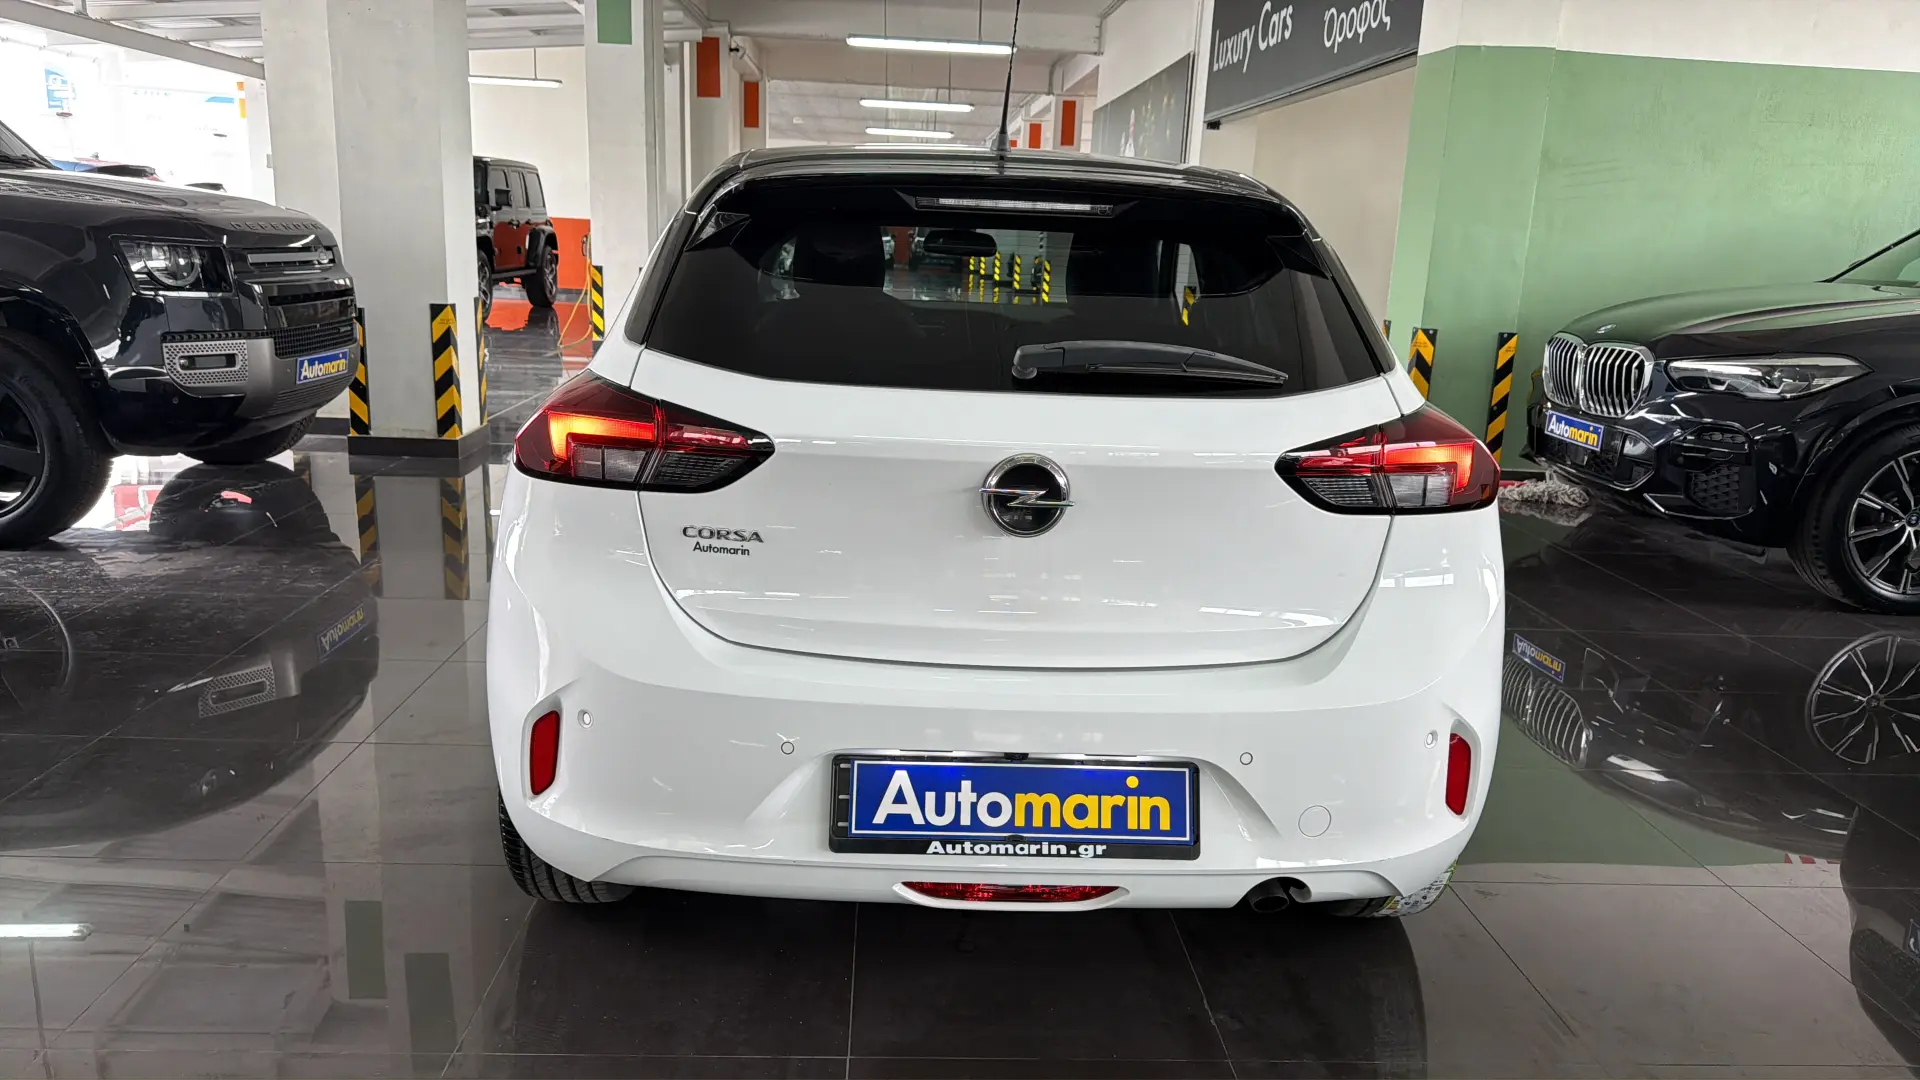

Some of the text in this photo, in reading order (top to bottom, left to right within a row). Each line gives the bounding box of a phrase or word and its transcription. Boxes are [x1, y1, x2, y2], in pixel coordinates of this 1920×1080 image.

[1213, 0, 1293, 75] Luxury Cars
[229, 221, 322, 232] DEFENDER
[300, 353, 346, 380] Automarin
[1547, 414, 1598, 447] Automarin
[682, 525, 764, 543] CORSA
[692, 541, 750, 556] Automarin
[872, 769, 1171, 831] Automarin
[926, 840, 1107, 859] Automarin.gr
